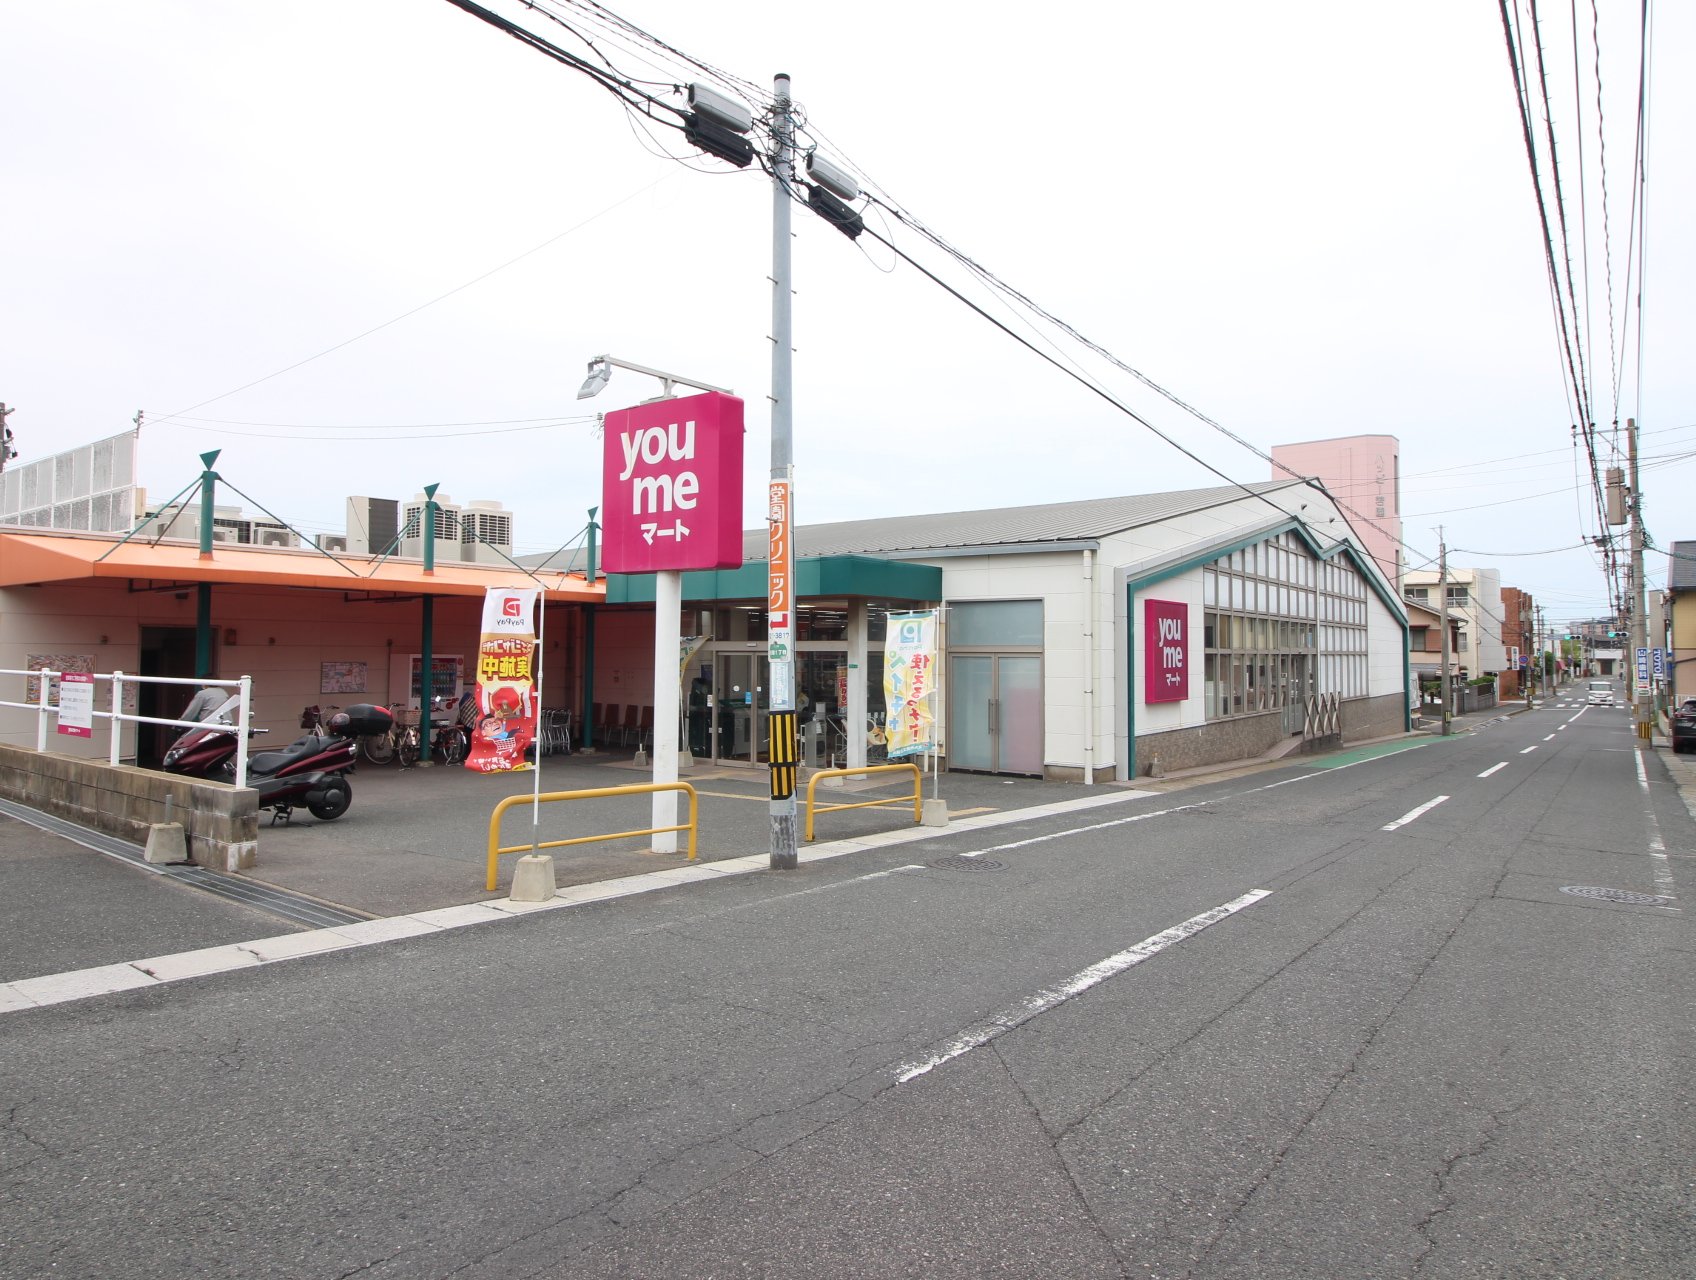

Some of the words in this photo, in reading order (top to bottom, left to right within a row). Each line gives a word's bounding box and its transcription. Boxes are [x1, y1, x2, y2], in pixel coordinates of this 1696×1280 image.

[619, 420, 696, 481] you
[632, 471, 699, 515] me
[640, 519, 690, 546] マート
[769, 486, 786, 609] 堂園クリニック
[1158, 617, 1181, 647] you
[1163, 646, 1183, 669] me
[1653, 649, 1661, 673] TOTO
[1165, 672, 1181, 687] マート
